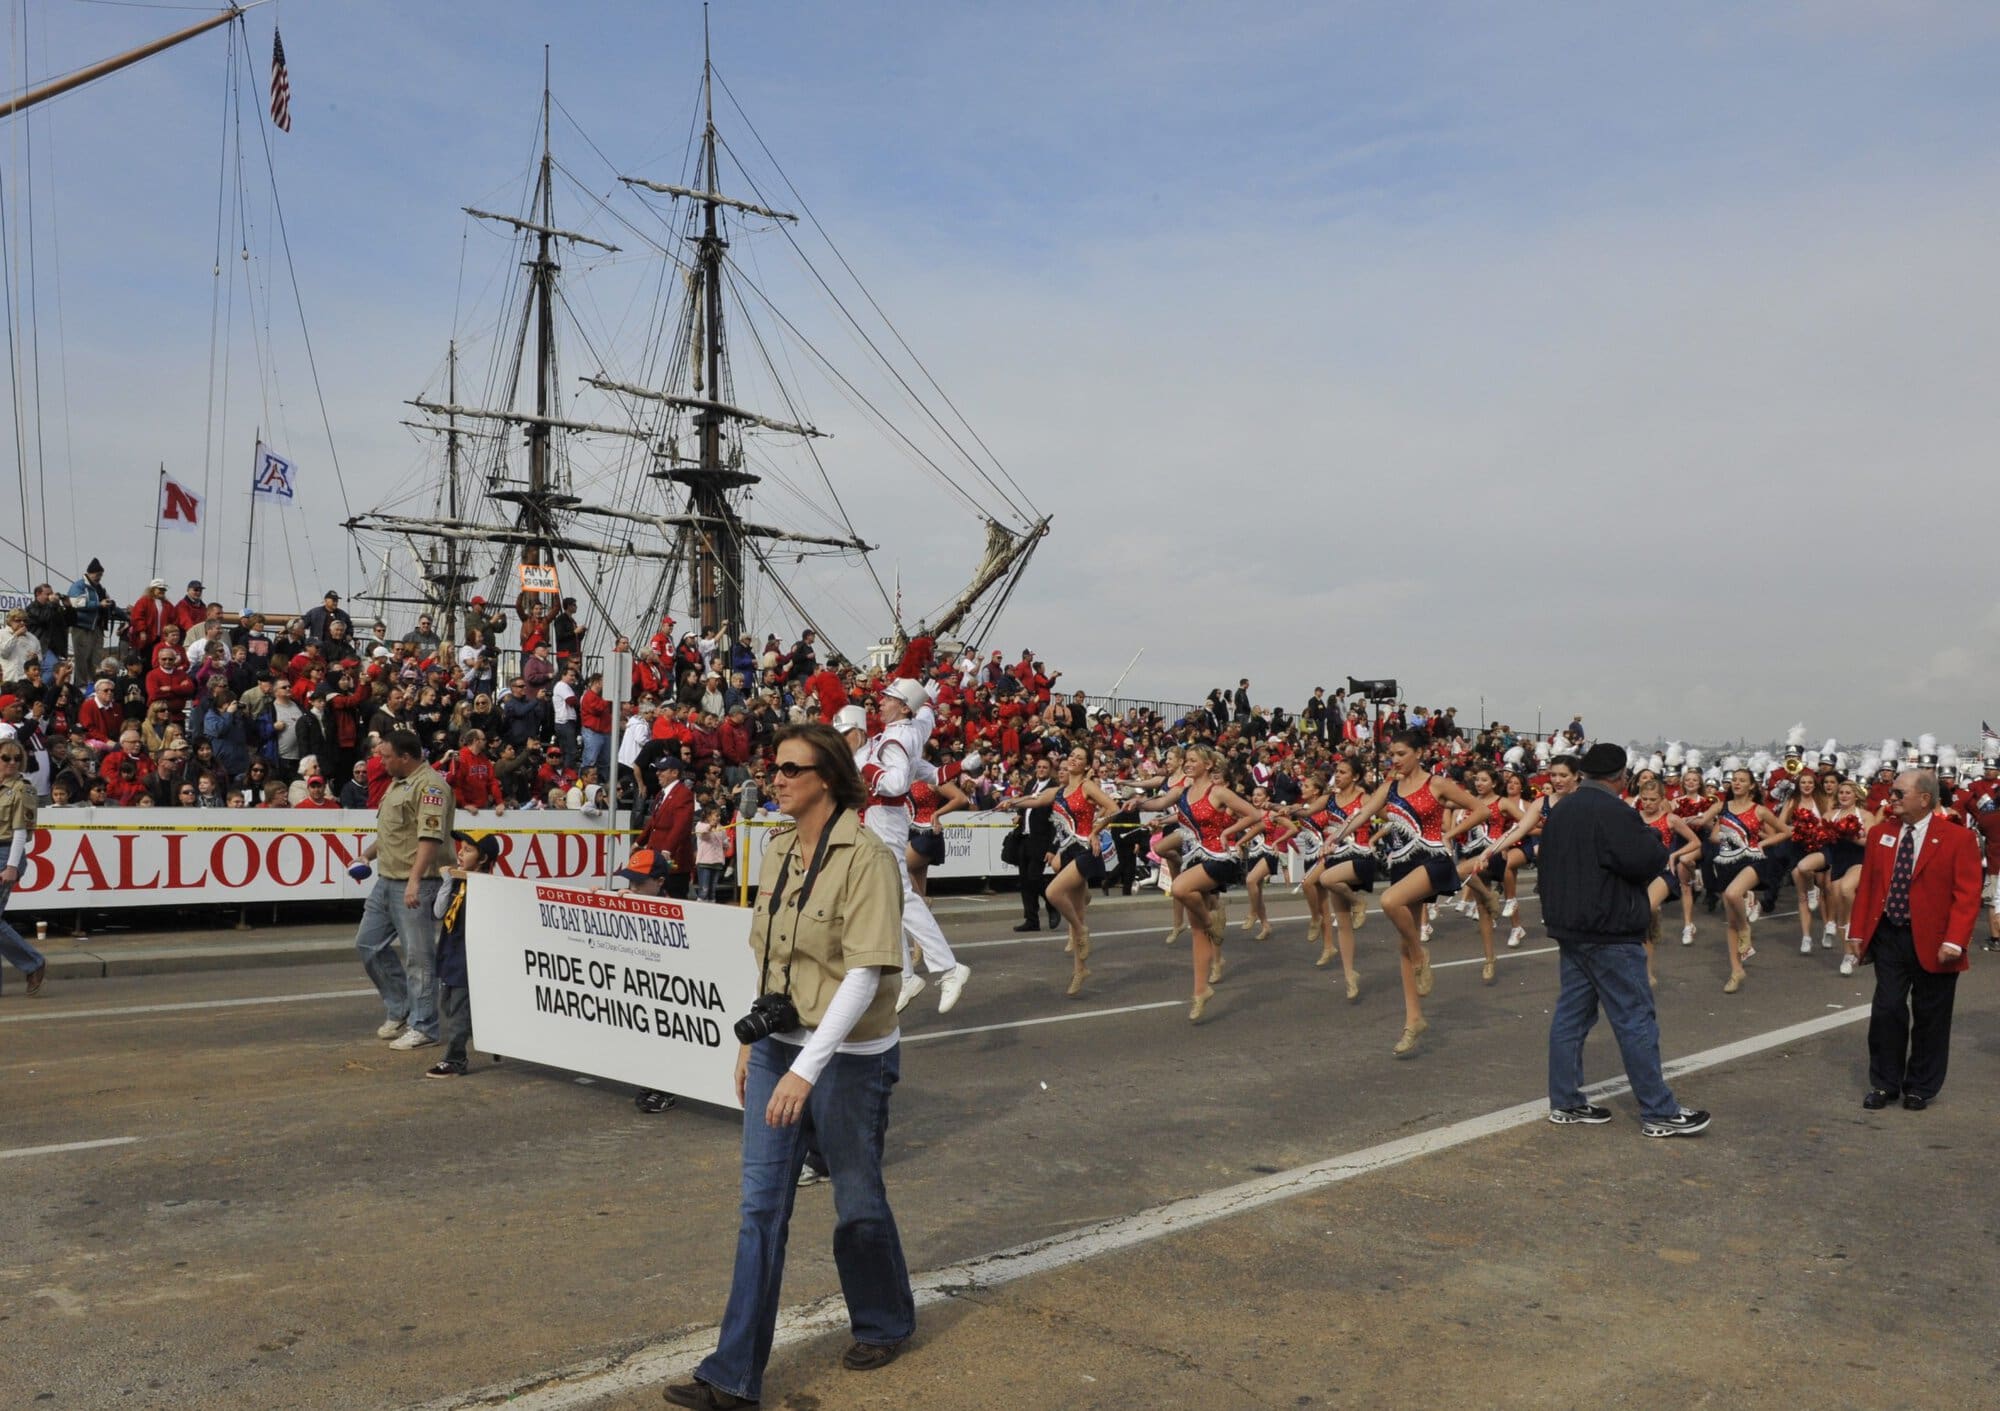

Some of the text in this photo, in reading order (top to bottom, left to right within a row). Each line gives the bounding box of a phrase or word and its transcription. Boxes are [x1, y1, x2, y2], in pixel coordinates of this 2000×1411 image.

[255, 454, 293, 498] A
[163, 482, 198, 523] N
[524, 566, 551, 578] AMY
[0, 594, 31, 609] ODAY
[455, 832, 622, 878] RADE
[944, 826, 973, 843] ounty
[12, 829, 367, 892] BALLOON
[538, 888, 681, 917] PORT OF SAN DIEGO
[539, 903, 689, 949] BIG BAY BALLOON PARADE
[524, 949, 726, 1013] PRIDE OF ARIZONA
[536, 985, 721, 1048] MARCHING BAND
